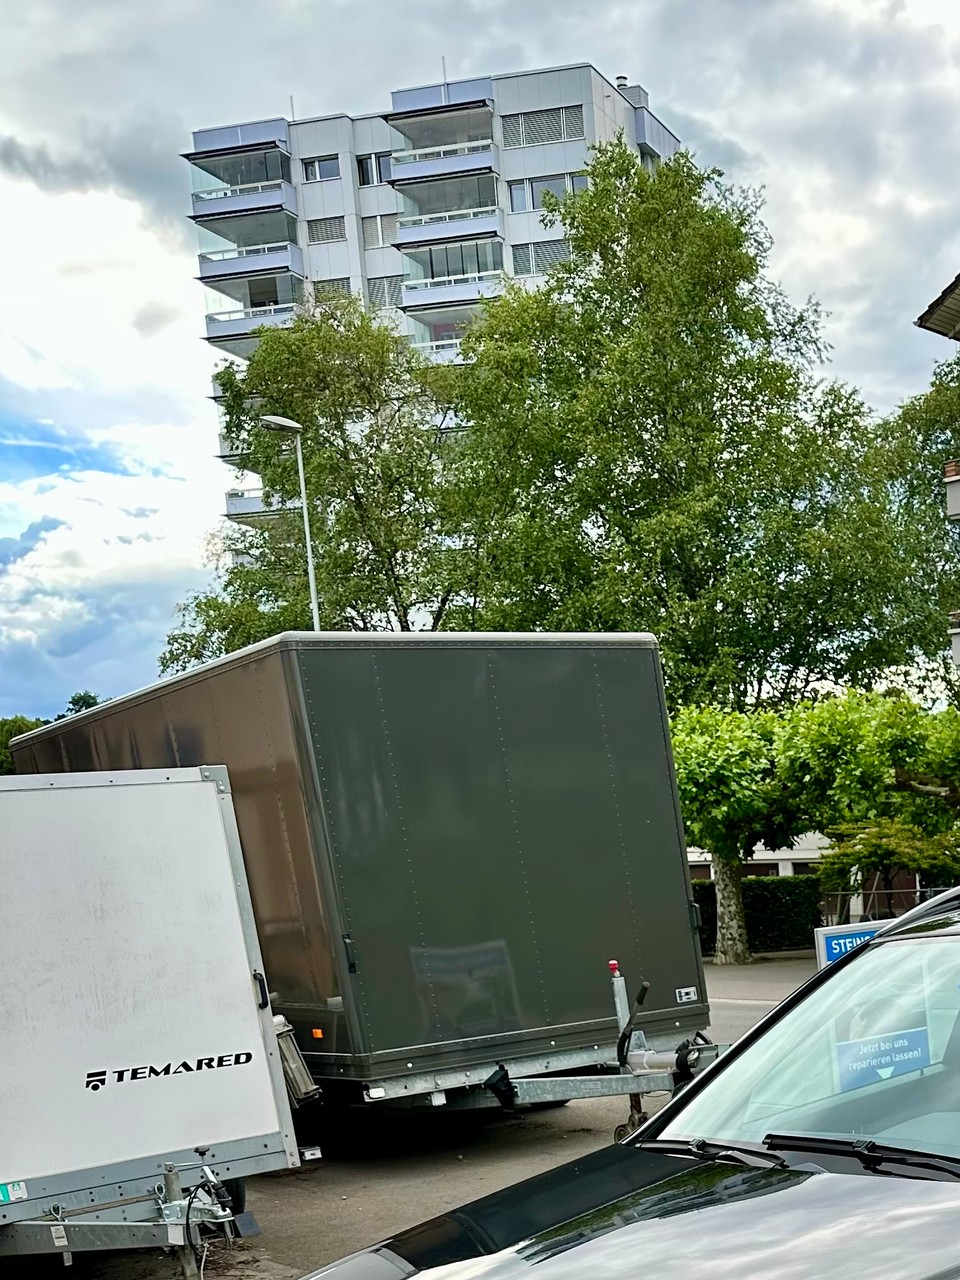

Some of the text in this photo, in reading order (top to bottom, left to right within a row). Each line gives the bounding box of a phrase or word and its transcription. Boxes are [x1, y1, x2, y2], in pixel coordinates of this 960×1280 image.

[859, 1038, 909, 1055] Jetzt bei uns
[112, 1052, 253, 1083] TEMARED
[848, 1048, 922, 1071] reparieren lassen!
